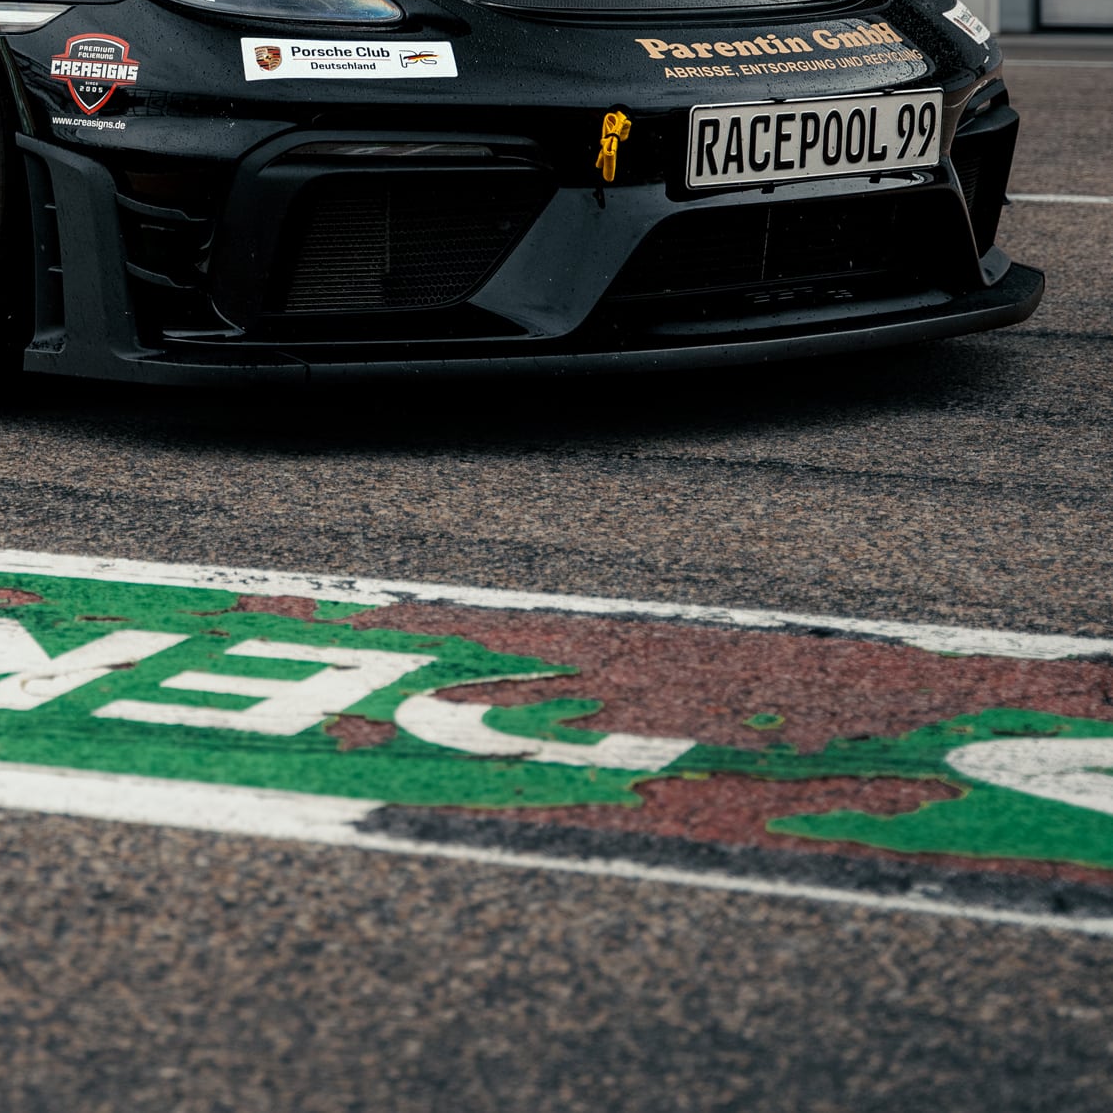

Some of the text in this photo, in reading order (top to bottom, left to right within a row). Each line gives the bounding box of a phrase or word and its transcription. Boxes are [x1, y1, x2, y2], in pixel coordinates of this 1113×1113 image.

[78, 45, 115, 54] PREMIUM
[635, 22, 904, 60] Parentin GmbH
[290, 46, 391, 58] Porsche Club
[50, 59, 139, 81] CREASIGNS
[310, 61, 377, 70] Deutschland
[664, 64, 740, 79] ABRISSE,
[741, 57, 836, 76] ENTSORGUNG
[836, 54, 864, 69] UND
[52, 116, 126, 130] www.creasigns.de
[695, 101, 937, 177] RACEPOOL 99
